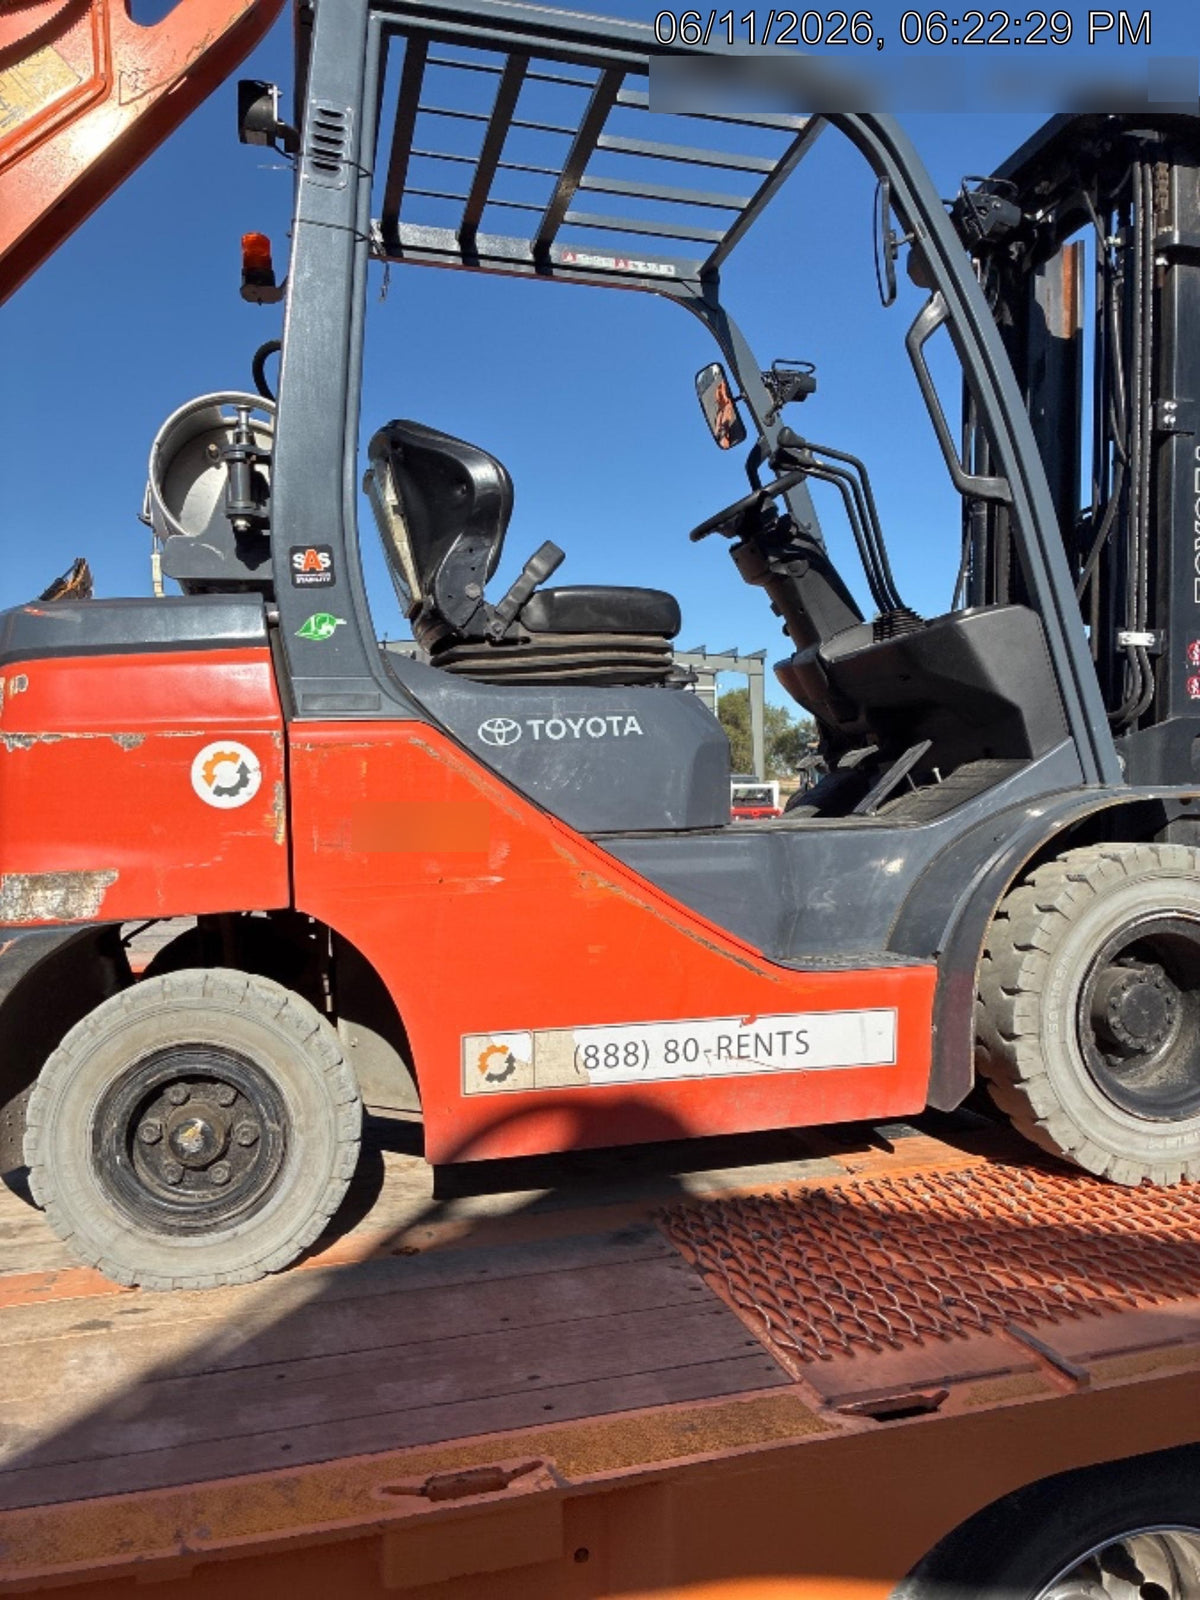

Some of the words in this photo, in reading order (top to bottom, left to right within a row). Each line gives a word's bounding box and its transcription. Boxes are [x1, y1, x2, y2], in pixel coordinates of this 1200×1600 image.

[292, 549, 331, 572] SAS
[526, 716, 644, 741] TOYOTA
[573, 1040, 650, 1075] (888)
[664, 1029, 810, 1064] 80-RENTS
